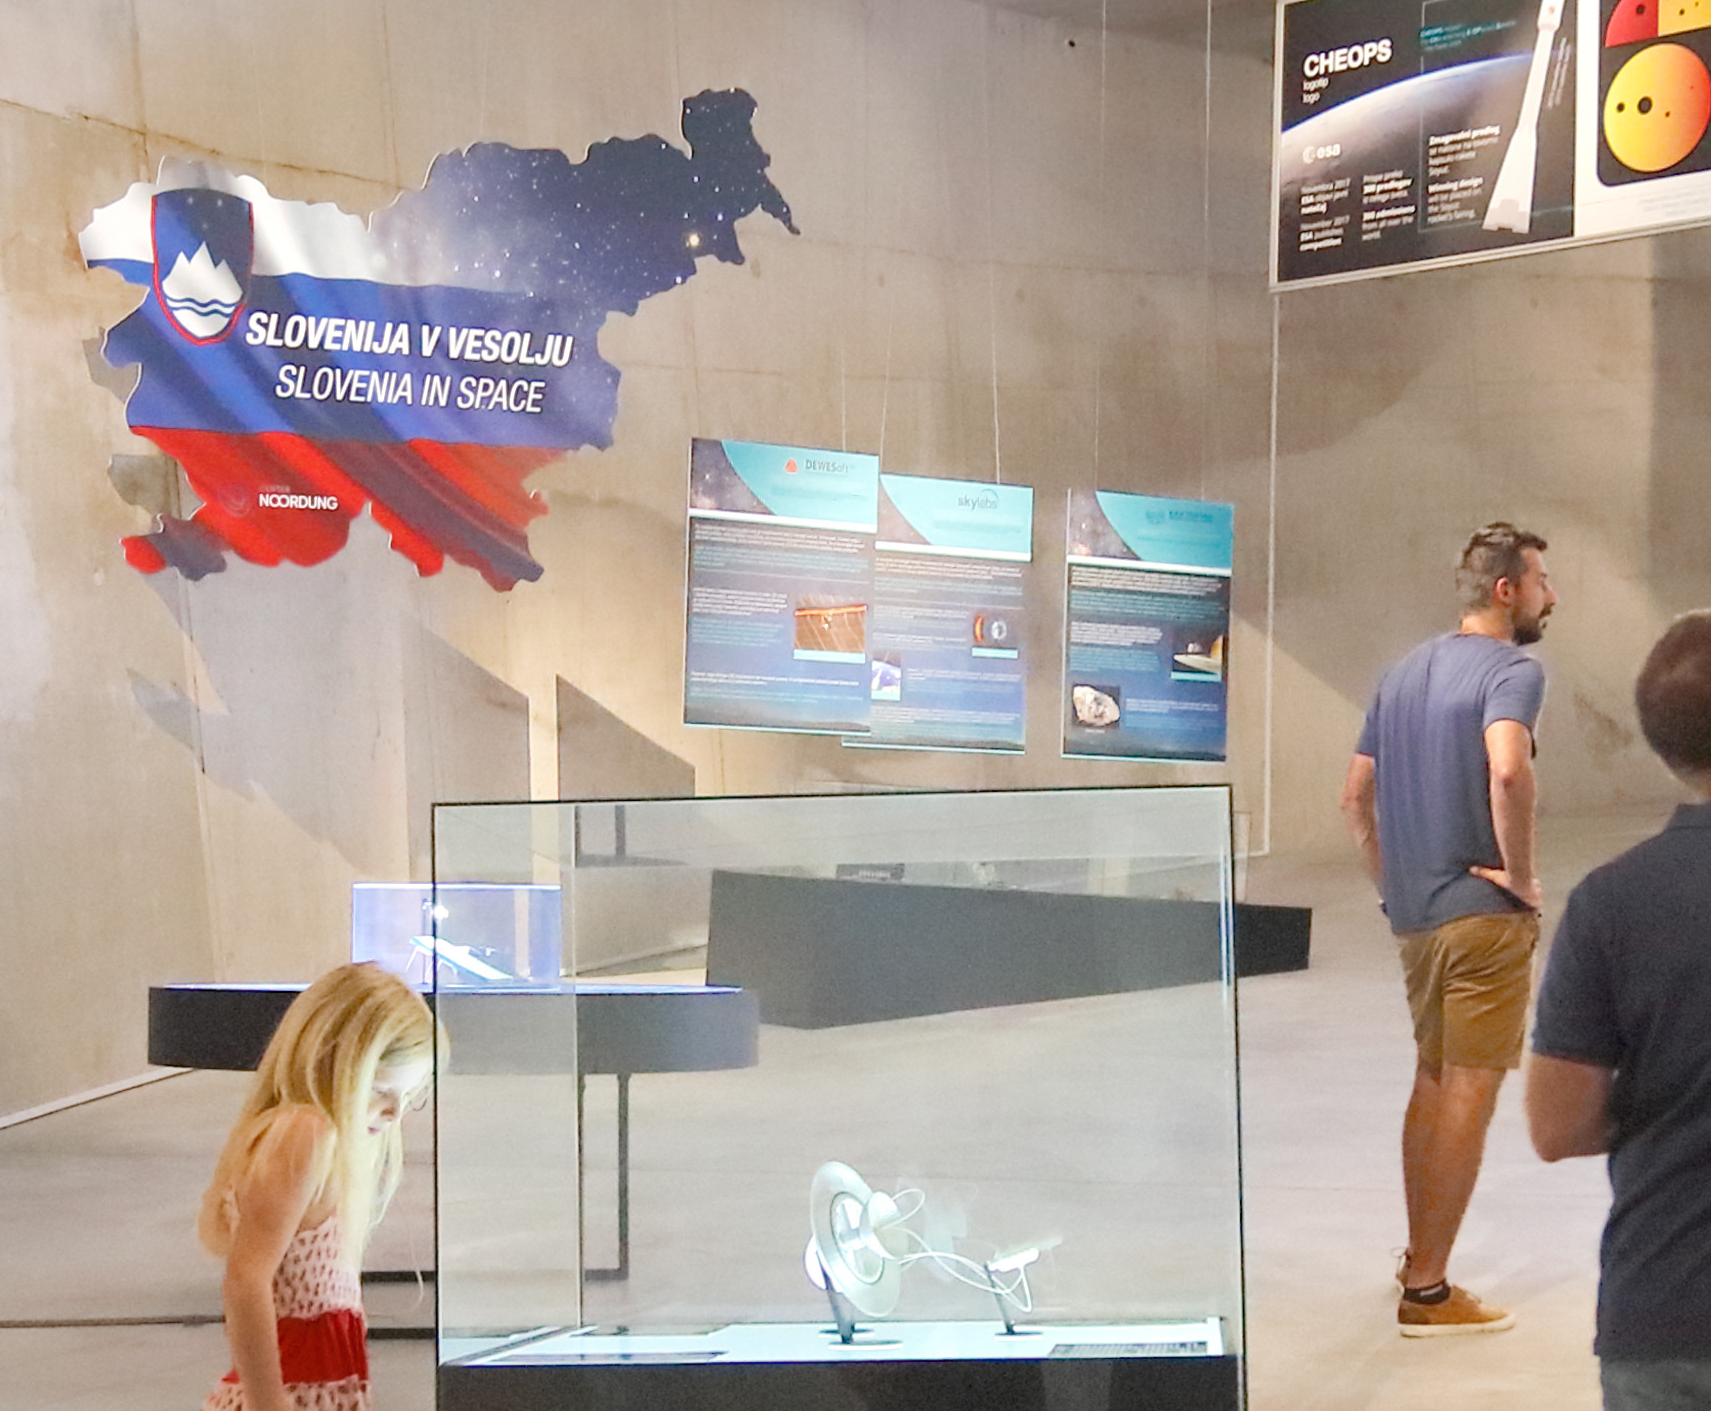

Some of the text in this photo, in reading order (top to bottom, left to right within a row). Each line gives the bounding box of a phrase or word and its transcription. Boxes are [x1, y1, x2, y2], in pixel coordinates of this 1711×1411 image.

[1304, 38, 1393, 78] CHEOPS
[1302, 77, 1329, 91] logotip
[1302, 92, 1320, 104] logo
[245, 310, 575, 368] SLOVENIJA V VESOLJU
[275, 363, 546, 414] SLOVENIA IN SPACE
[259, 493, 338, 510] NOORDUNG
